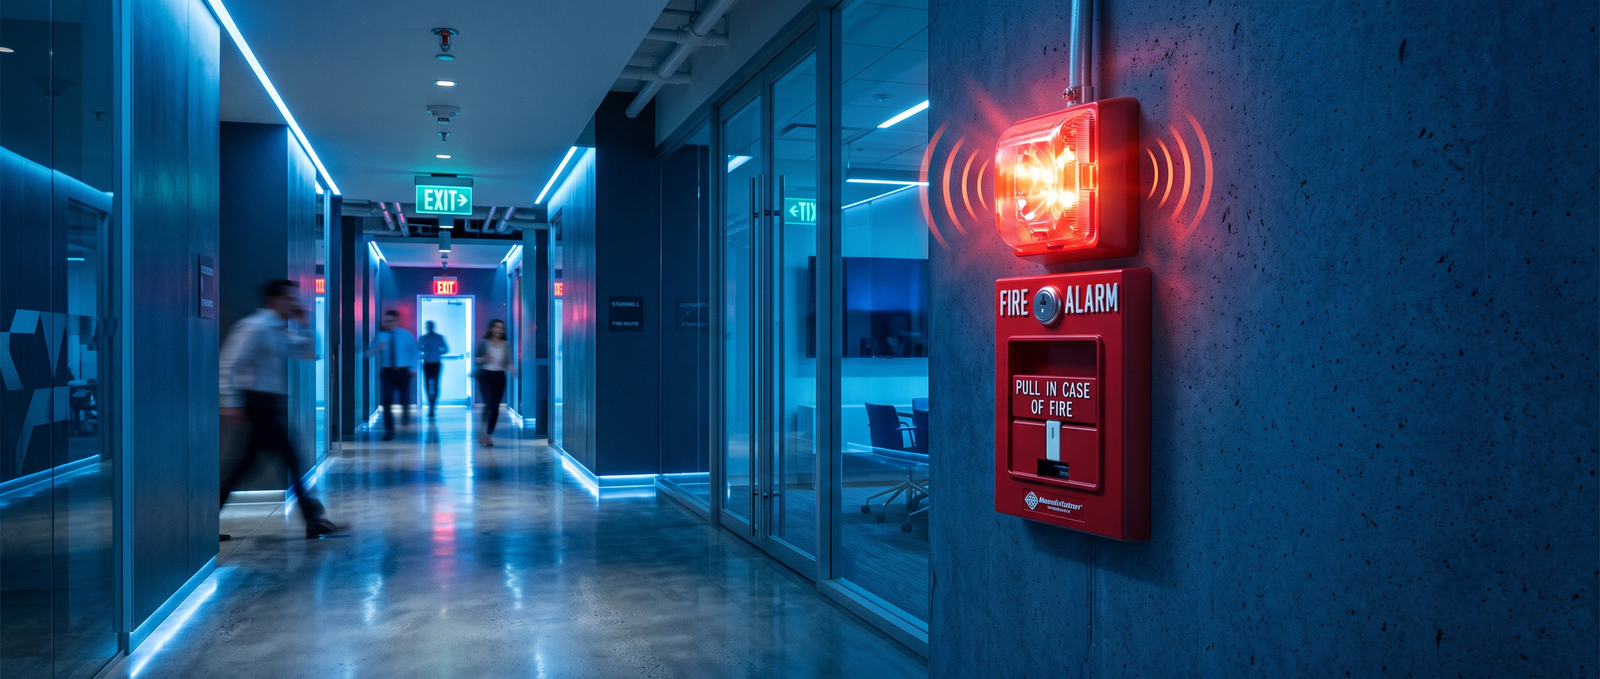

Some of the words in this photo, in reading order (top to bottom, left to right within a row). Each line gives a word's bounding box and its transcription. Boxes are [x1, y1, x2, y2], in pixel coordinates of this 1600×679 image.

[424, 188, 457, 211] EXIT
[437, 281, 455, 294] EXIT
[1000, 288, 1029, 316] FIRE
[1064, 282, 1119, 314] ALARM
[1016, 379, 1041, 396] PULL
[1046, 381, 1057, 397] IN
[1062, 381, 1091, 399] CASE
[1031, 399, 1045, 415] OF
[1049, 400, 1073, 417] FIRE
